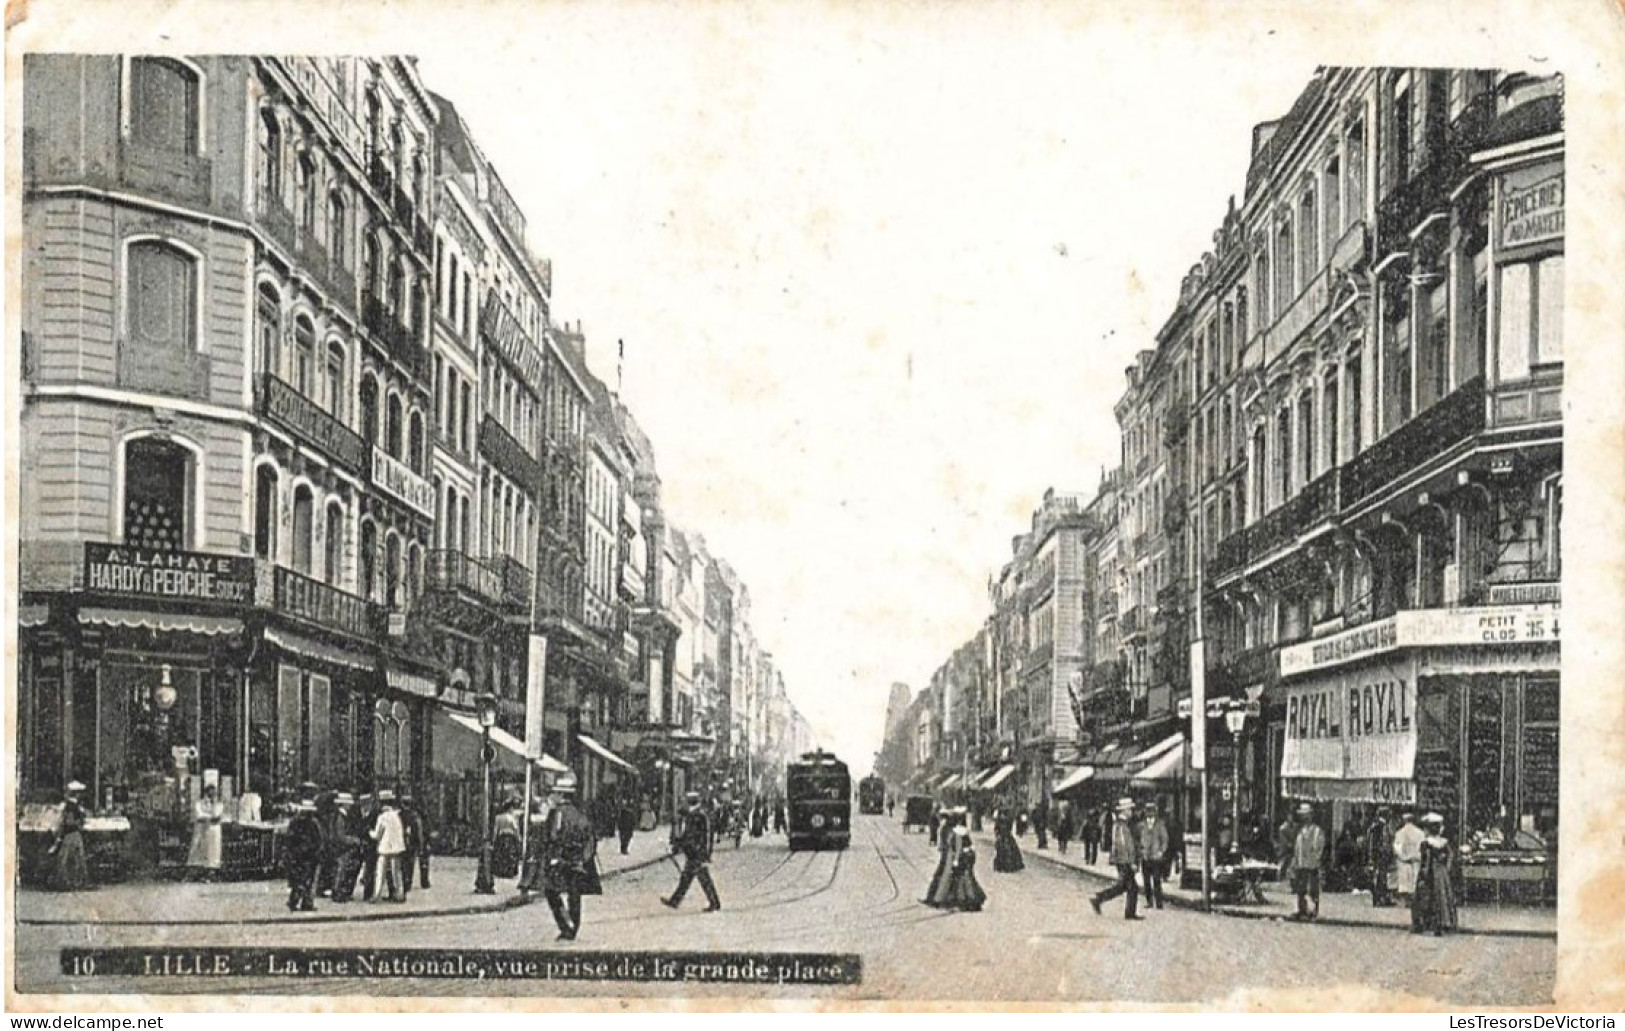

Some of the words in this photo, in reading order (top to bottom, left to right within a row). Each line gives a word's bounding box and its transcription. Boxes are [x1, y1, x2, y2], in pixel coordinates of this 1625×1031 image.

[136, 551, 231, 573] LAHAYE
[90, 562, 143, 591] HARDY
[153, 567, 216, 598] PERCHE
[1478, 615, 1516, 628] PETIT
[1482, 629, 1516, 641] CLOS
[1289, 690, 1340, 739] ROYAL
[1349, 680, 1410, 737] ROYAL
[1372, 779, 1413, 801] ROYAL
